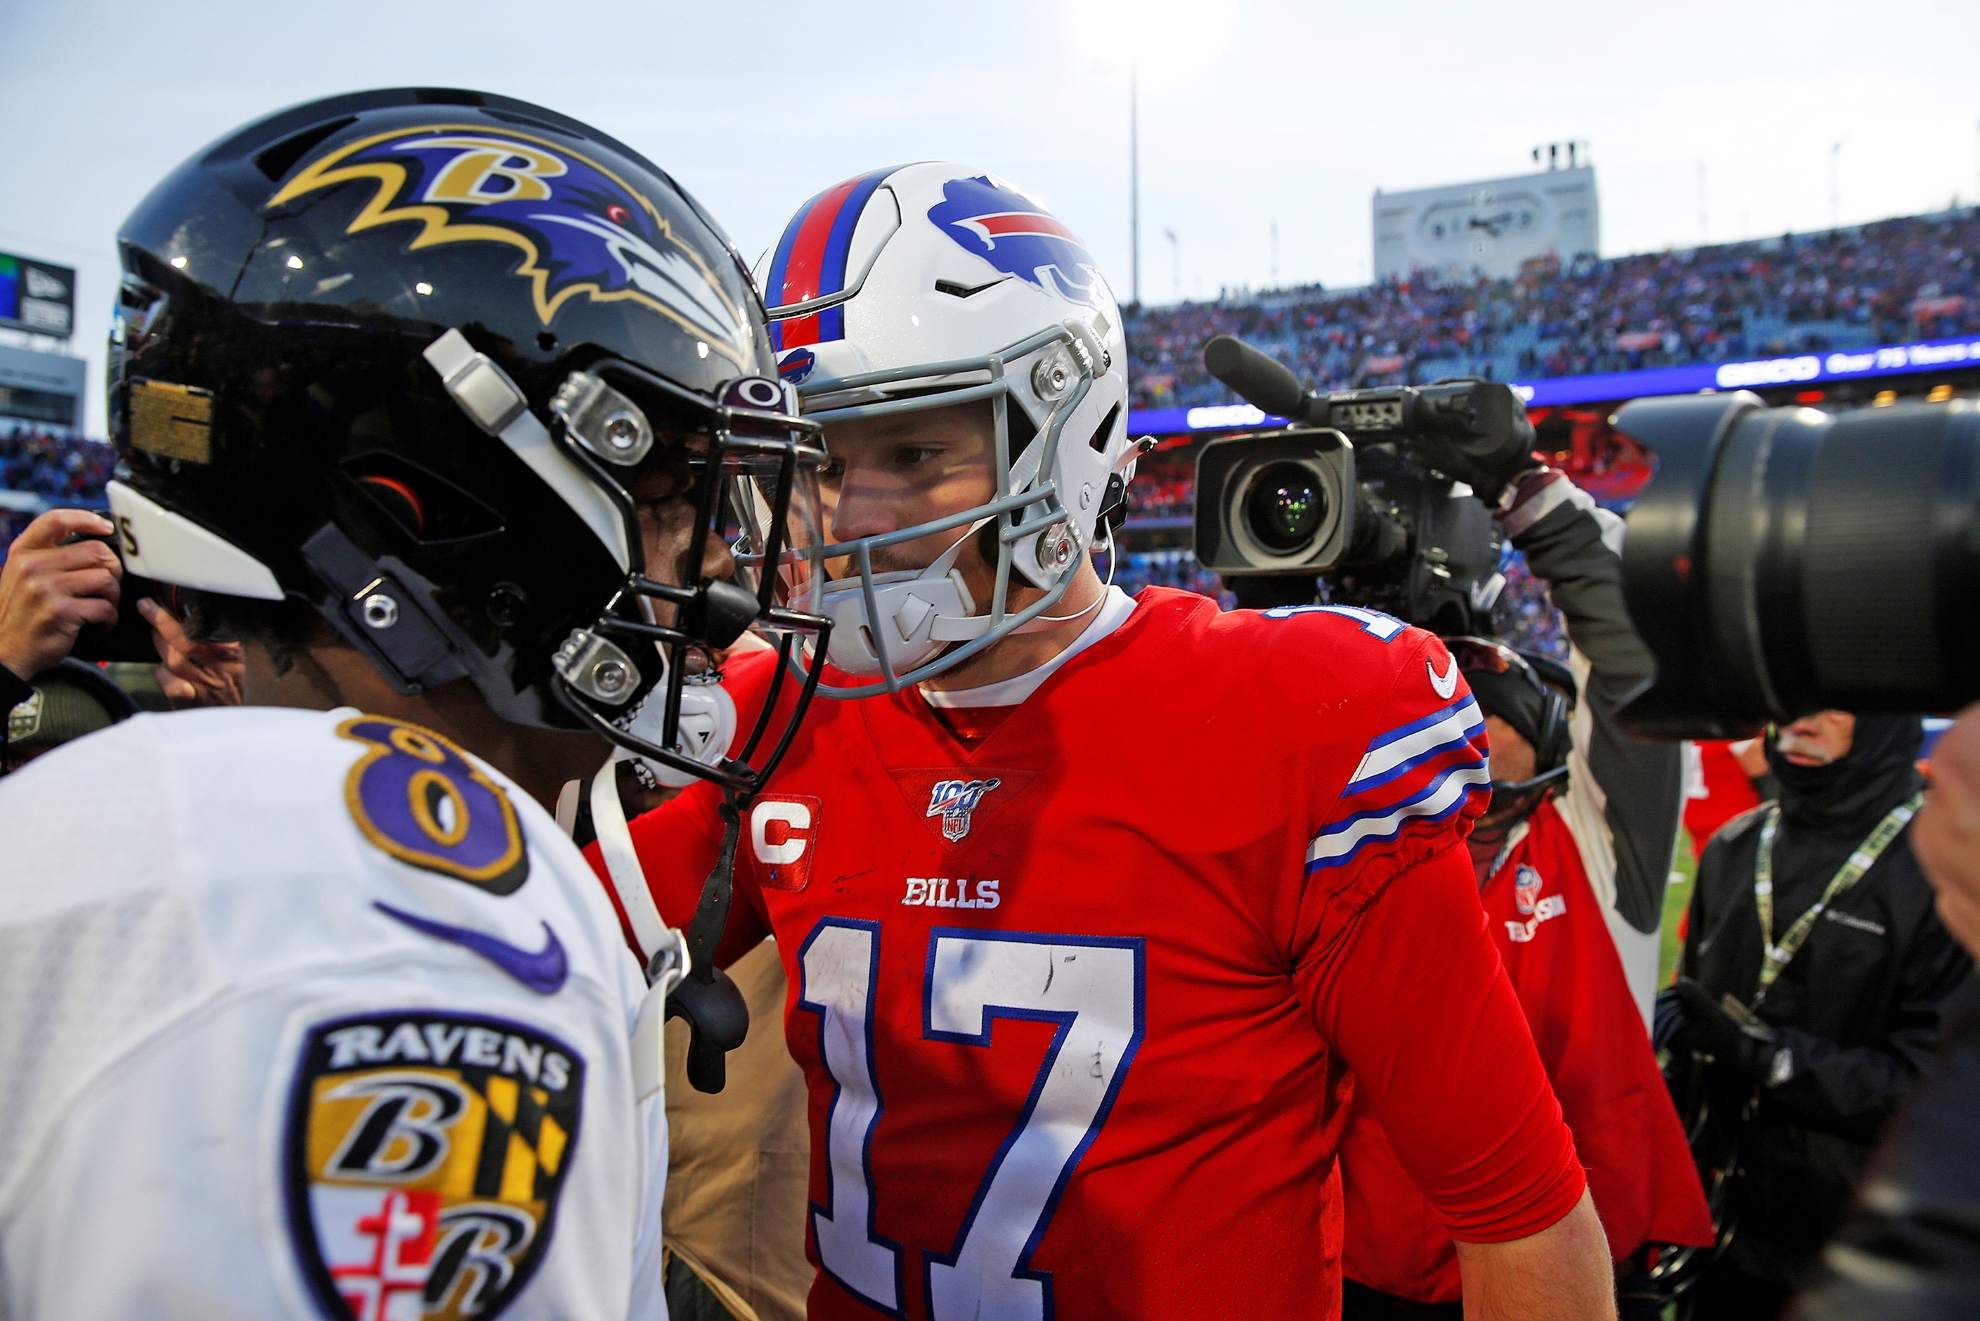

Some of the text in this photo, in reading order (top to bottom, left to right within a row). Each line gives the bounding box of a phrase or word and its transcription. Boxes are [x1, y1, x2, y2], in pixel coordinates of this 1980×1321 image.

[1716, 355, 1821, 388] GEICO
[750, 800, 812, 866] C
[901, 876, 1001, 910] BILLS
[323, 1021, 571, 1092] RAVENS
[316, 1070, 472, 1184] B
[797, 914, 1147, 1321] 17
